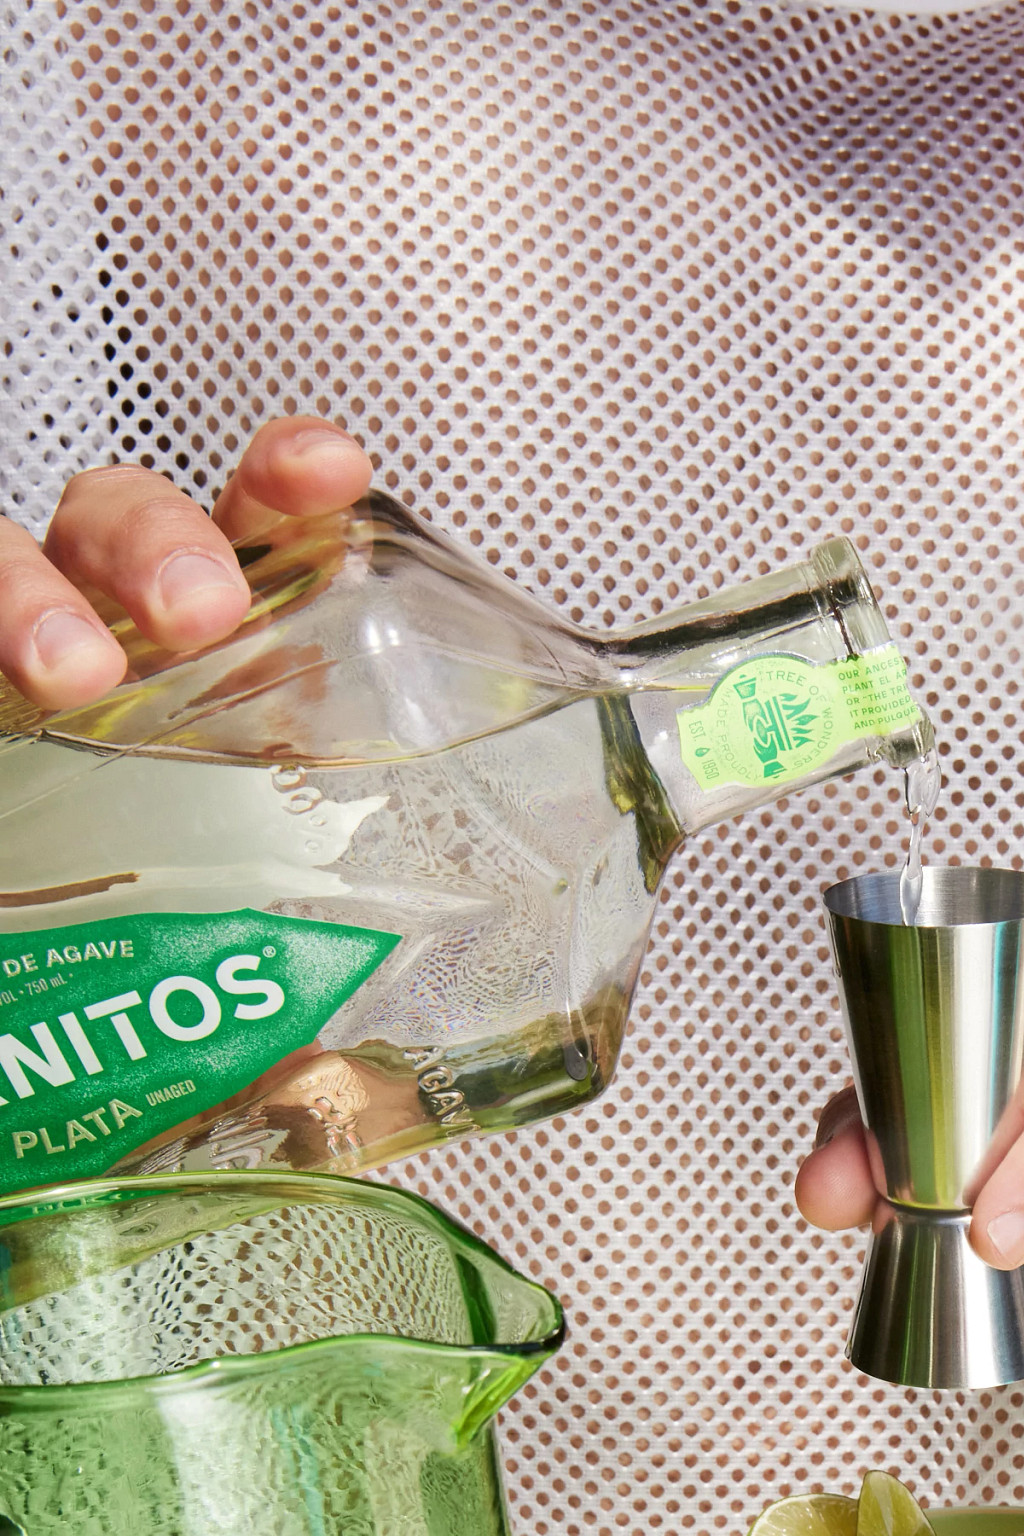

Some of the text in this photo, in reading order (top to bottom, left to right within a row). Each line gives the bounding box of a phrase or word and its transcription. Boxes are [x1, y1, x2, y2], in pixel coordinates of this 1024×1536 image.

[838, 669, 859, 681] OUR
[842, 680, 874, 694] PLANT
[879, 676, 891, 685] EL
[846, 697, 860, 705] OR
[849, 695, 911, 718] IT PROVIDED
[765, 670, 807, 687] TREE
[793, 707, 834, 769] WONDERS
[854, 719, 875, 730] AND
[716, 688, 762, 781] MADE PROUDLY
[701, 759, 720, 780] 1950
[3, 940, 134, 978] DE AGAVE
[0, 973, 68, 1006] OL 750 mL
[12, 1079, 196, 1159] PLATA UNAGED
